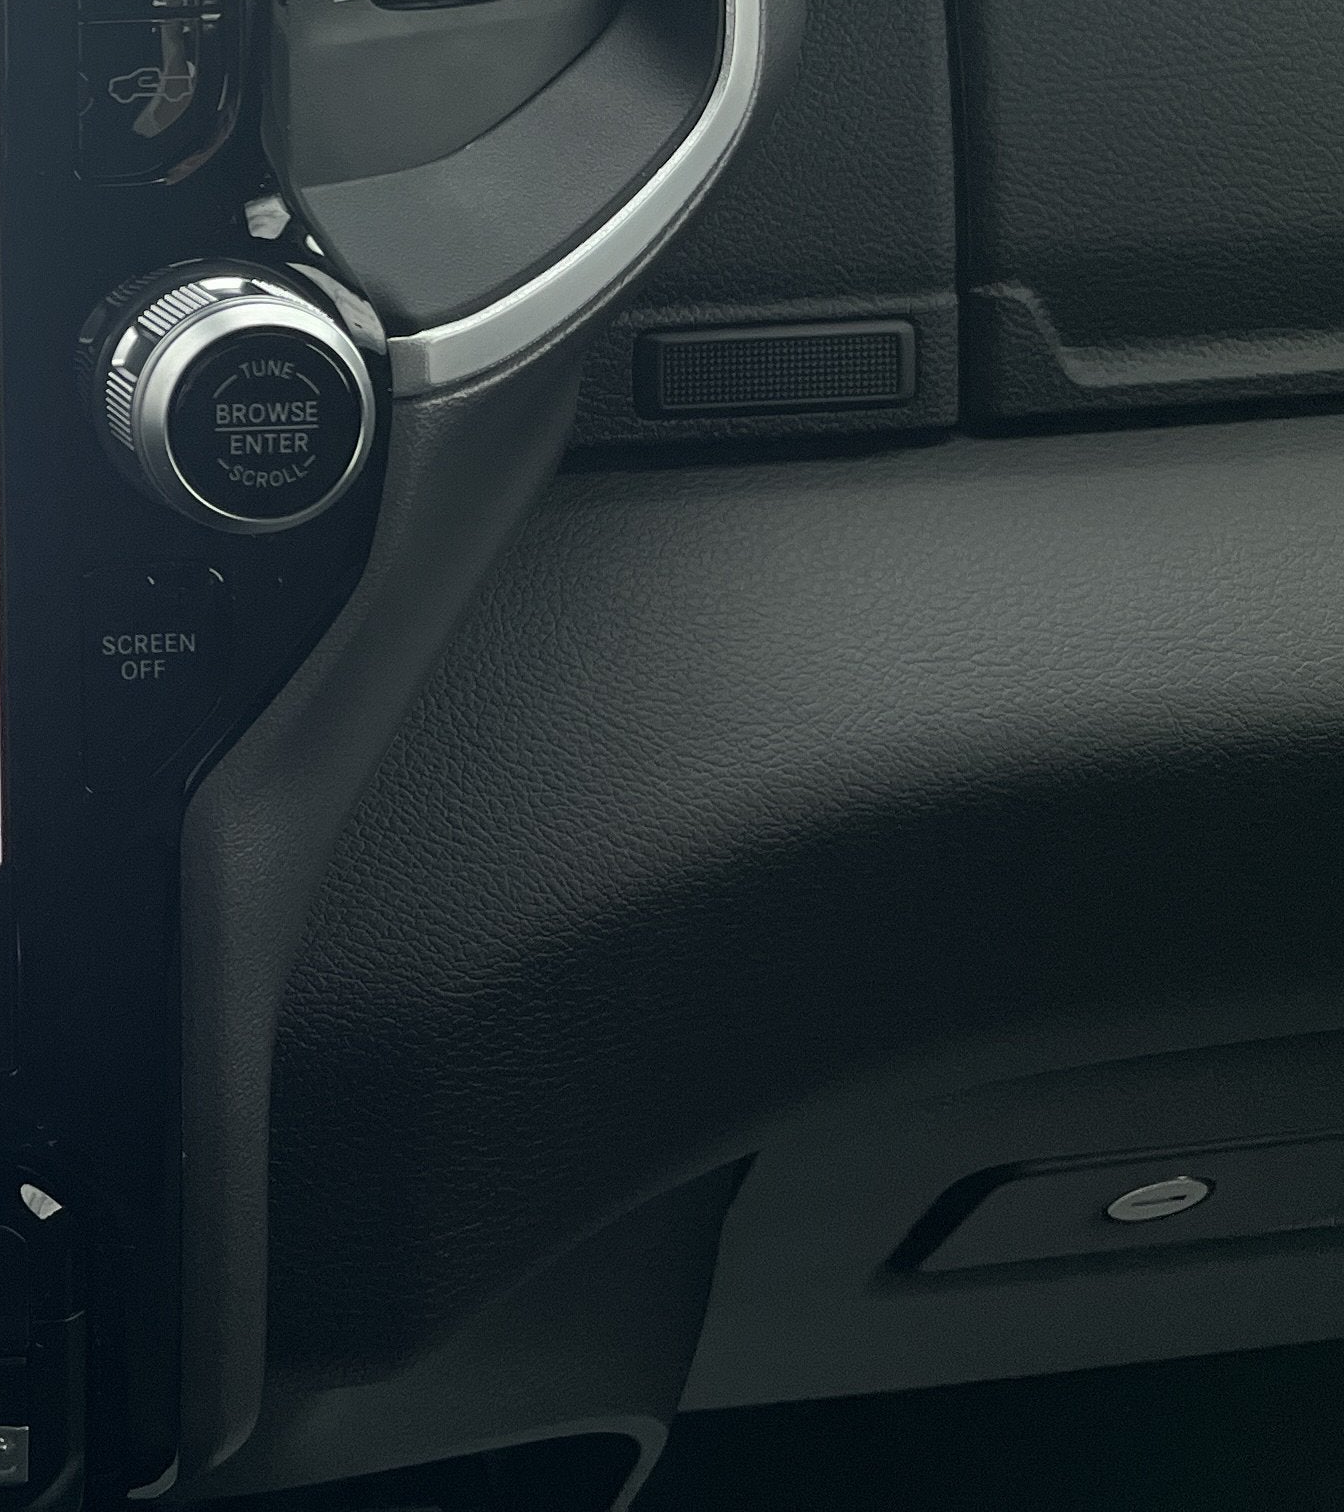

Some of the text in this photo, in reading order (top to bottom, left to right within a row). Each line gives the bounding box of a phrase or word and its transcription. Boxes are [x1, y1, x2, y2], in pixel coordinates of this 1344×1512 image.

[239, 359, 294, 379] TUNE
[216, 402, 319, 424] BROWSE
[230, 433, 308, 455] ENTER
[229, 464, 308, 488] SCROLL
[102, 634, 196, 655] SCREEN
[121, 660, 165, 680] OFF
